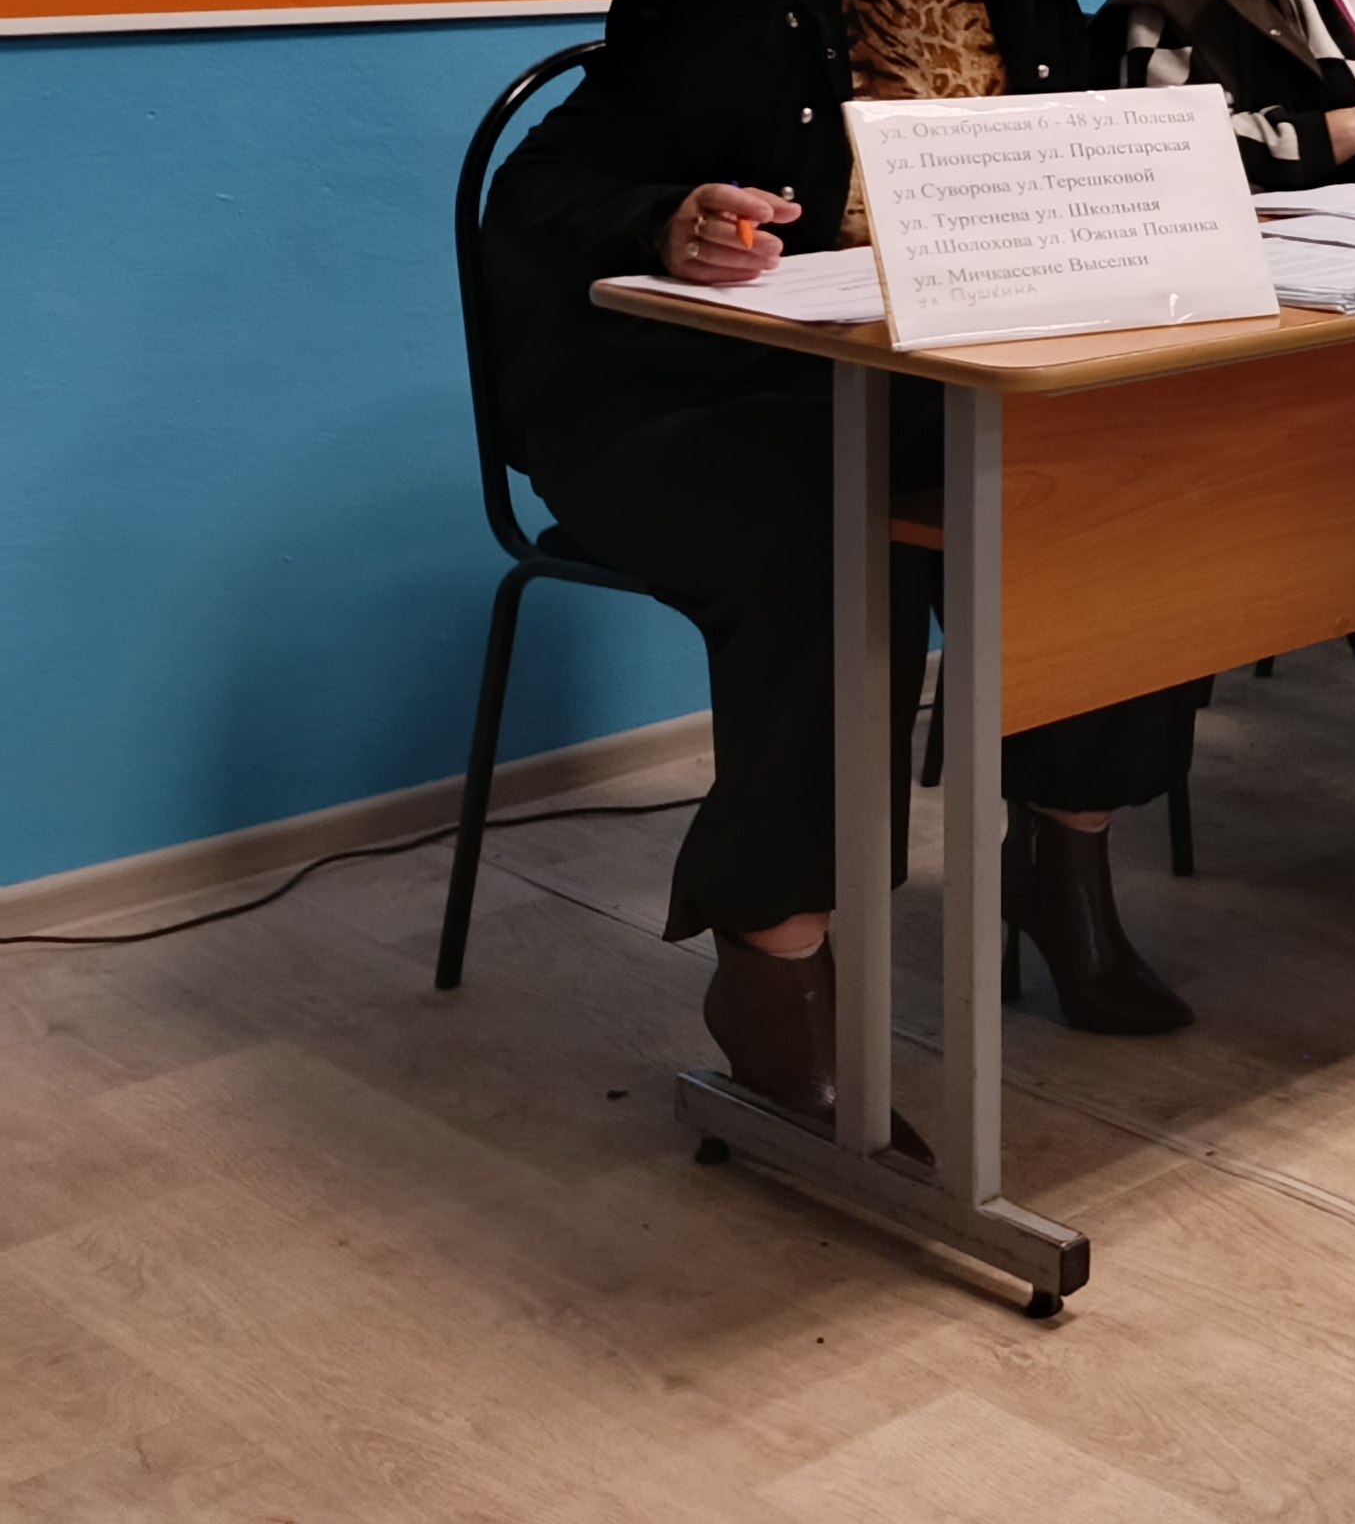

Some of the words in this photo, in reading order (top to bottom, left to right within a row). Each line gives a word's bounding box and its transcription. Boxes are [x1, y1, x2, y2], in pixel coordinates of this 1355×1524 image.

[880, 128, 907, 143] ул.
[913, 119, 1032, 138] Октябрьская
[1038, 115, 1048, 129] 6
[1066, 113, 1087, 127] 48
[1093, 114, 1118, 130] ул.
[1123, 110, 1195, 125] Полевая
[886, 158, 914, 174] ул.
[920, 149, 1032, 168] Пионерская
[1038, 148, 1064, 163] ул.
[1069, 140, 1191, 160] Пролетарская
[893, 188, 915, 204] ул
[921, 180, 1012, 201] Суворова
[900, 219, 928, 234] ул.
[932, 209, 1031, 231] Тургенева
[1036, 208, 1063, 224] ул.
[1067, 200, 1160, 218] Школьная
[1038, 232, 1065, 249] ул.
[1070, 225, 1138, 242] Южная
[1143, 220, 1219, 237] Полянка
[913, 275, 942, 292] ул.
[946, 262, 1063, 285] Мичкасские
[1069, 254, 1149, 272] Выселки
